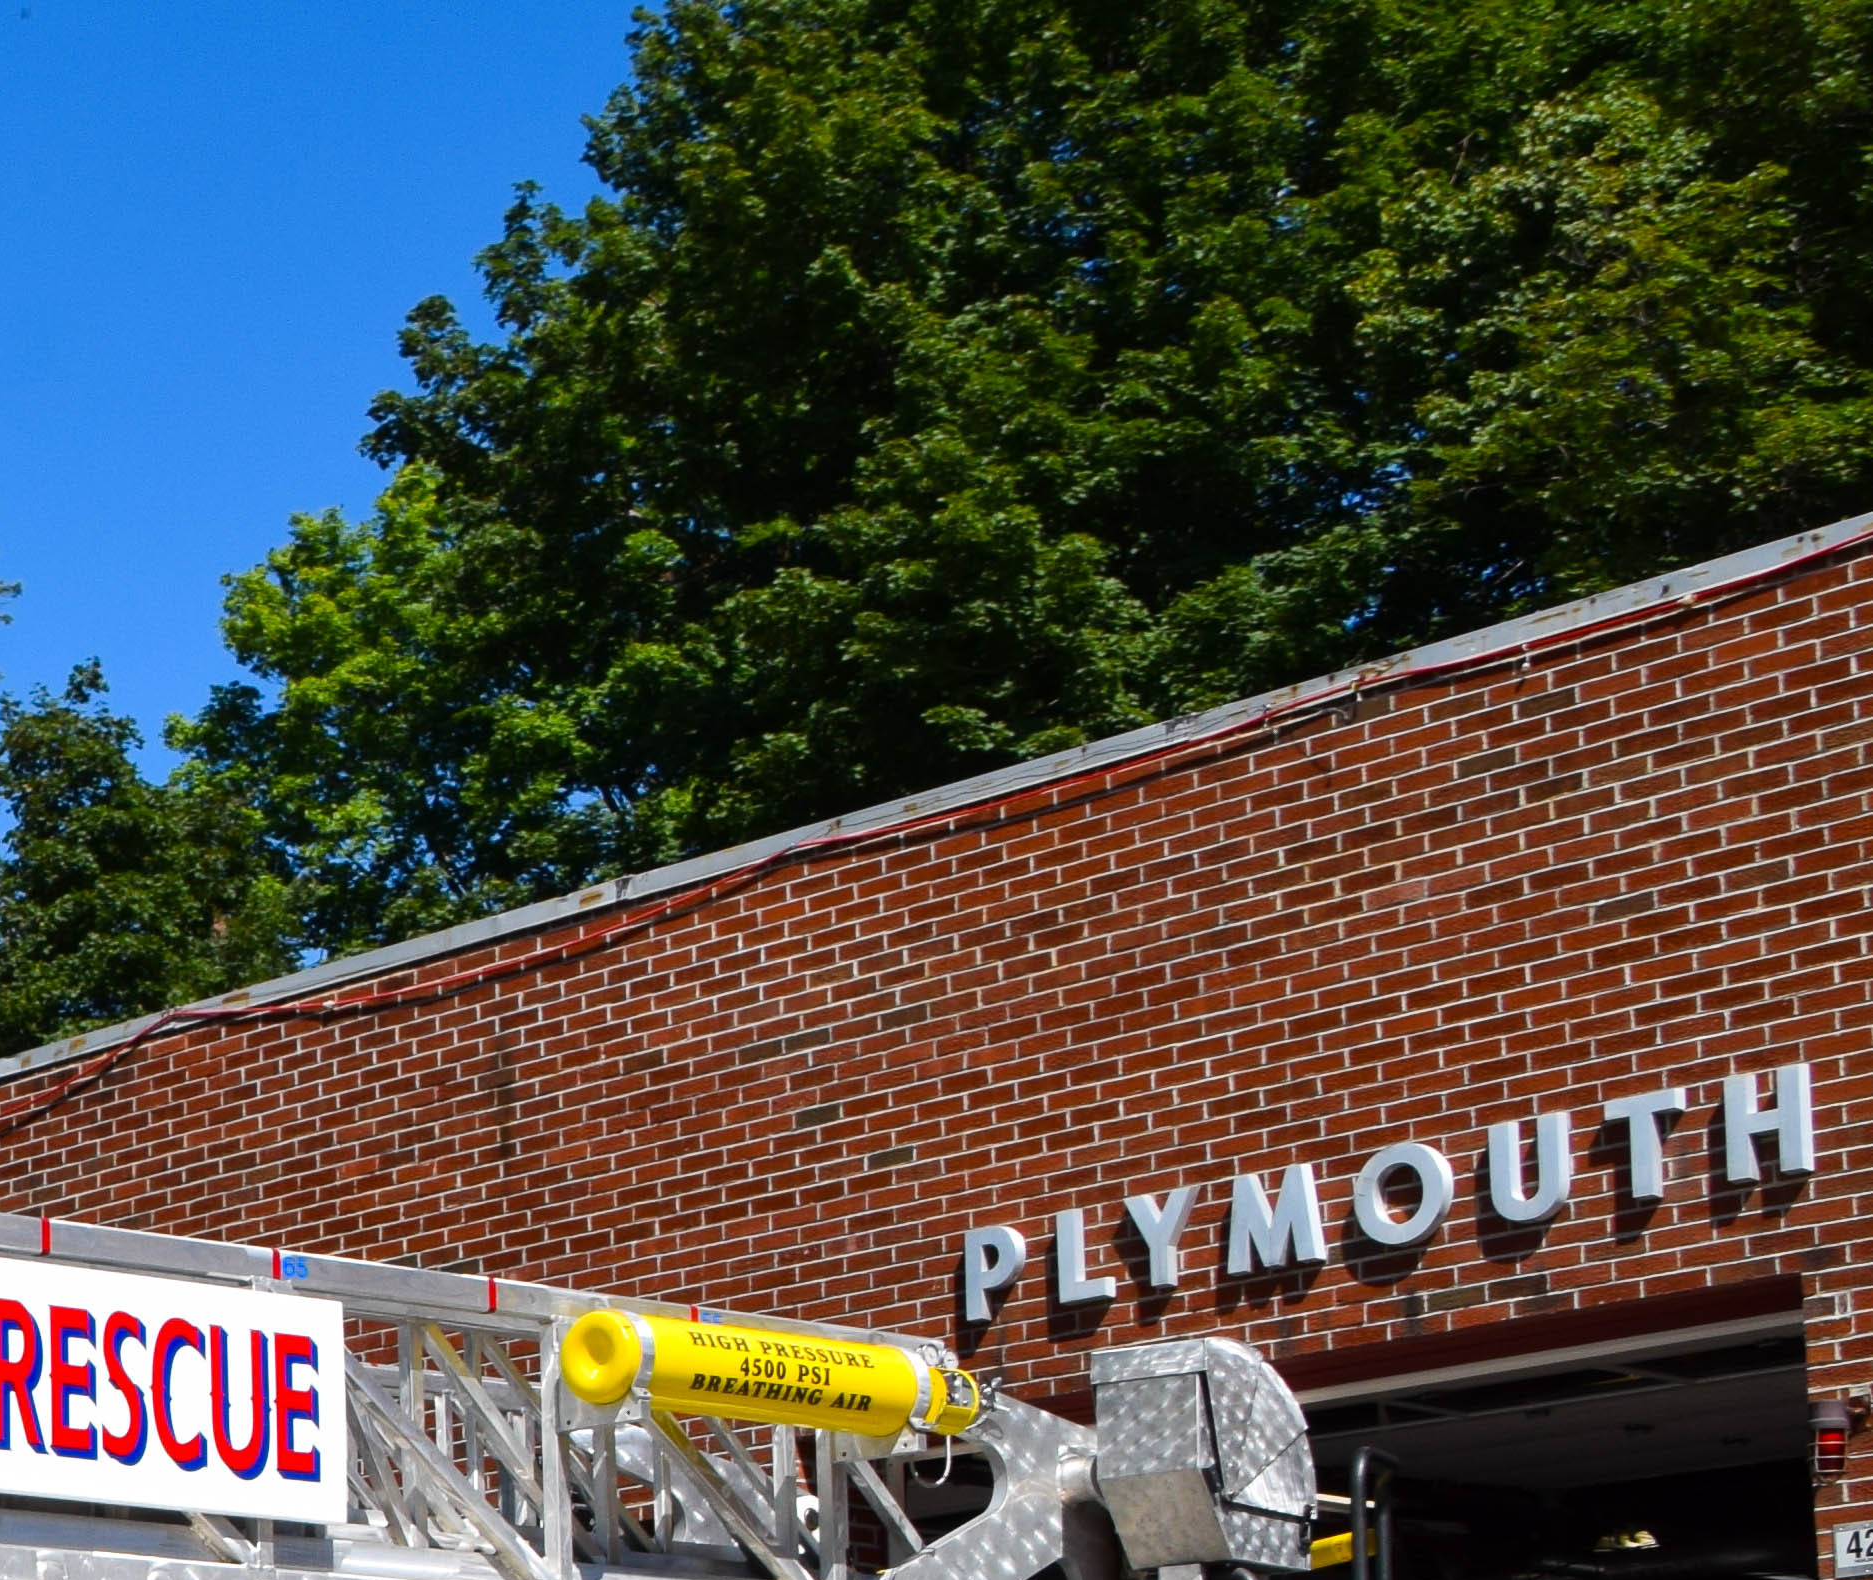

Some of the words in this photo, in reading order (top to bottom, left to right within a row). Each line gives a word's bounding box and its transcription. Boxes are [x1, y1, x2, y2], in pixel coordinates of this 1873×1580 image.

[964, 1063, 1816, 1322] PLYMOUTH
[283, 1255, 309, 1280] 65
[689, 1331, 750, 1352] HIGH
[759, 1341, 875, 1368] PRESSURE
[740, 1357, 786, 1380] 4500
[798, 1364, 831, 1386] PSI
[690, 1373, 823, 1405] BREATHING
[830, 1392, 872, 1411] AIR
